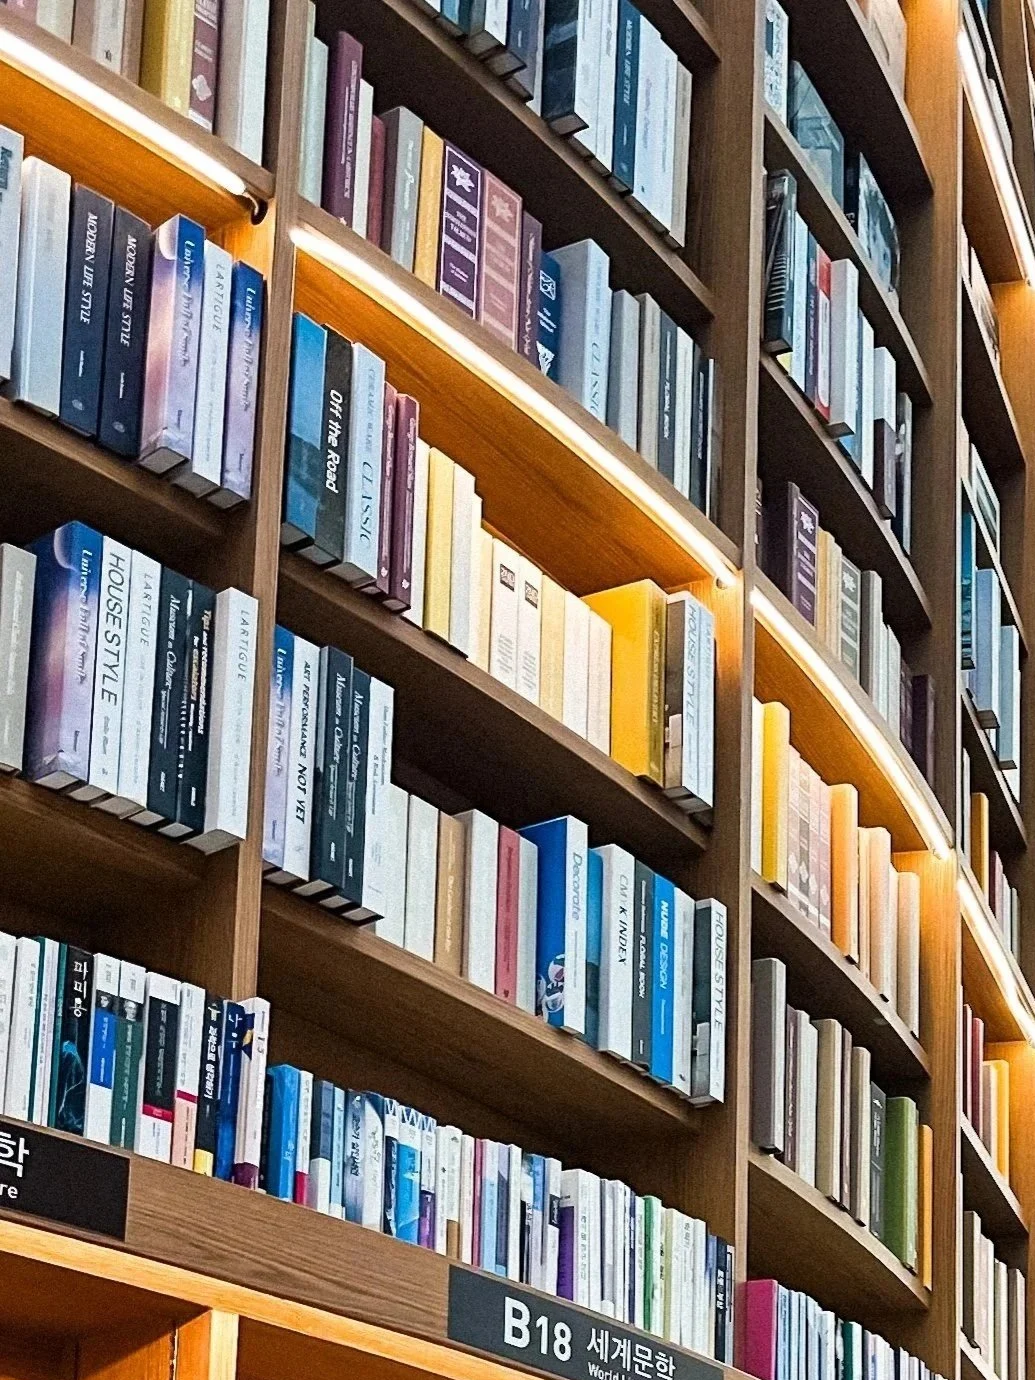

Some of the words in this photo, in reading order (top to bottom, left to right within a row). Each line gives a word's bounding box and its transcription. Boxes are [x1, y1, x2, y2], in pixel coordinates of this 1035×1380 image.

[85, 212, 98, 264] MODERN
[124, 234, 137, 285] MODERN
[84, 264, 94, 288] LIFE
[123, 287, 133, 309] LIFE
[211, 263, 225, 333] LARTIGUE
[80, 292, 91, 325] STYLE
[120, 312, 131, 348] STYLE
[330, 388, 344, 420] Off
[327, 420, 342, 447] the
[325, 448, 341, 493] Road
[359, 461, 374, 549] CLASSIC
[105, 552, 126, 630] HOUSE
[140, 572, 153, 647] LARTIGUE
[202, 609, 212, 631] Tips
[686, 604, 696, 659] HOUSE
[101, 630, 121, 706] STYLE
[238, 609, 250, 681] LARTIGUE
[165, 650, 177, 690] Culture
[197, 647, 208, 735] recommendations
[303, 660, 311, 681] ART
[684, 664, 695, 724] STYLE
[297, 763, 308, 795] NOT
[295, 799, 306, 825] YET
[571, 851, 583, 921] Decorate
[617, 918, 628, 966] INDEX
[660, 900, 669, 939] NUDE
[714, 910, 724, 970] HOUSE
[659, 941, 668, 989] DESIGN
[713, 972, 724, 1032] STYLE
[503, 1296, 572, 1362] B18
